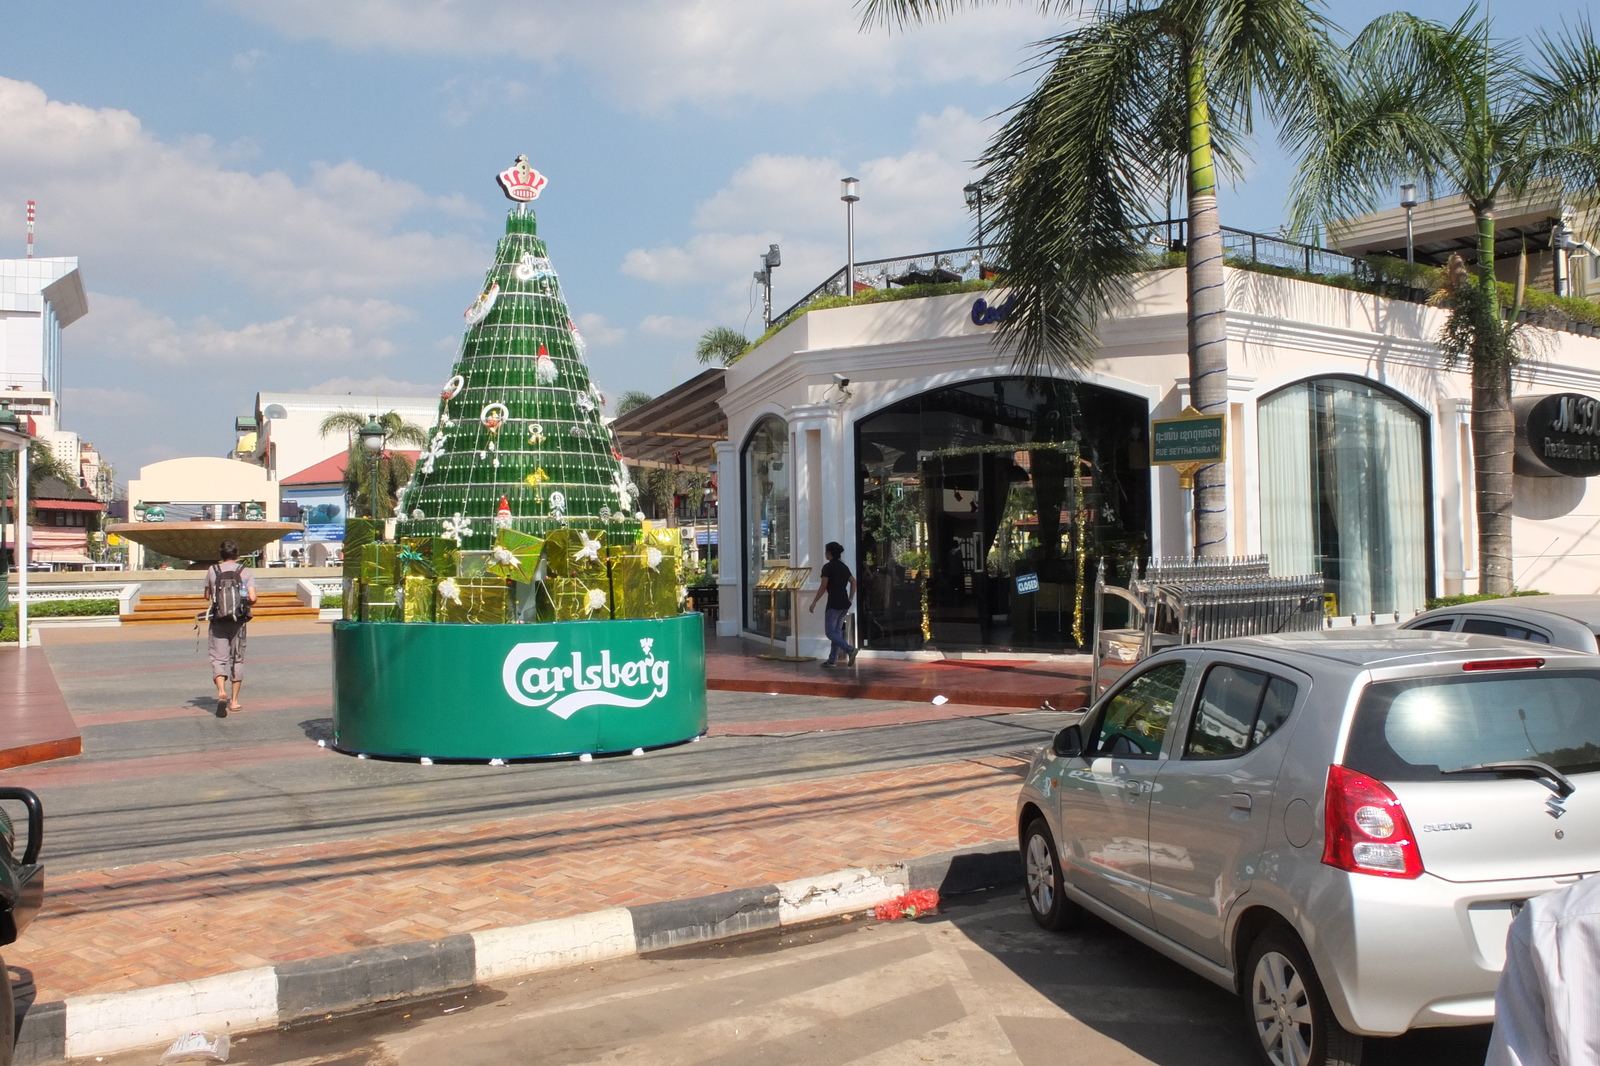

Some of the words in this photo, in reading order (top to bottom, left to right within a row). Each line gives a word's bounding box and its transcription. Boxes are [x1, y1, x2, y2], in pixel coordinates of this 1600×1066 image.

[1155, 448, 1168, 456] RUE
[1169, 445, 1220, 456] SETTHATHIRATH
[1018, 580, 1037, 591] CLOSED
[502, 638, 670, 708] Carlsberg
[1423, 822, 1473, 833] SUZUKI
